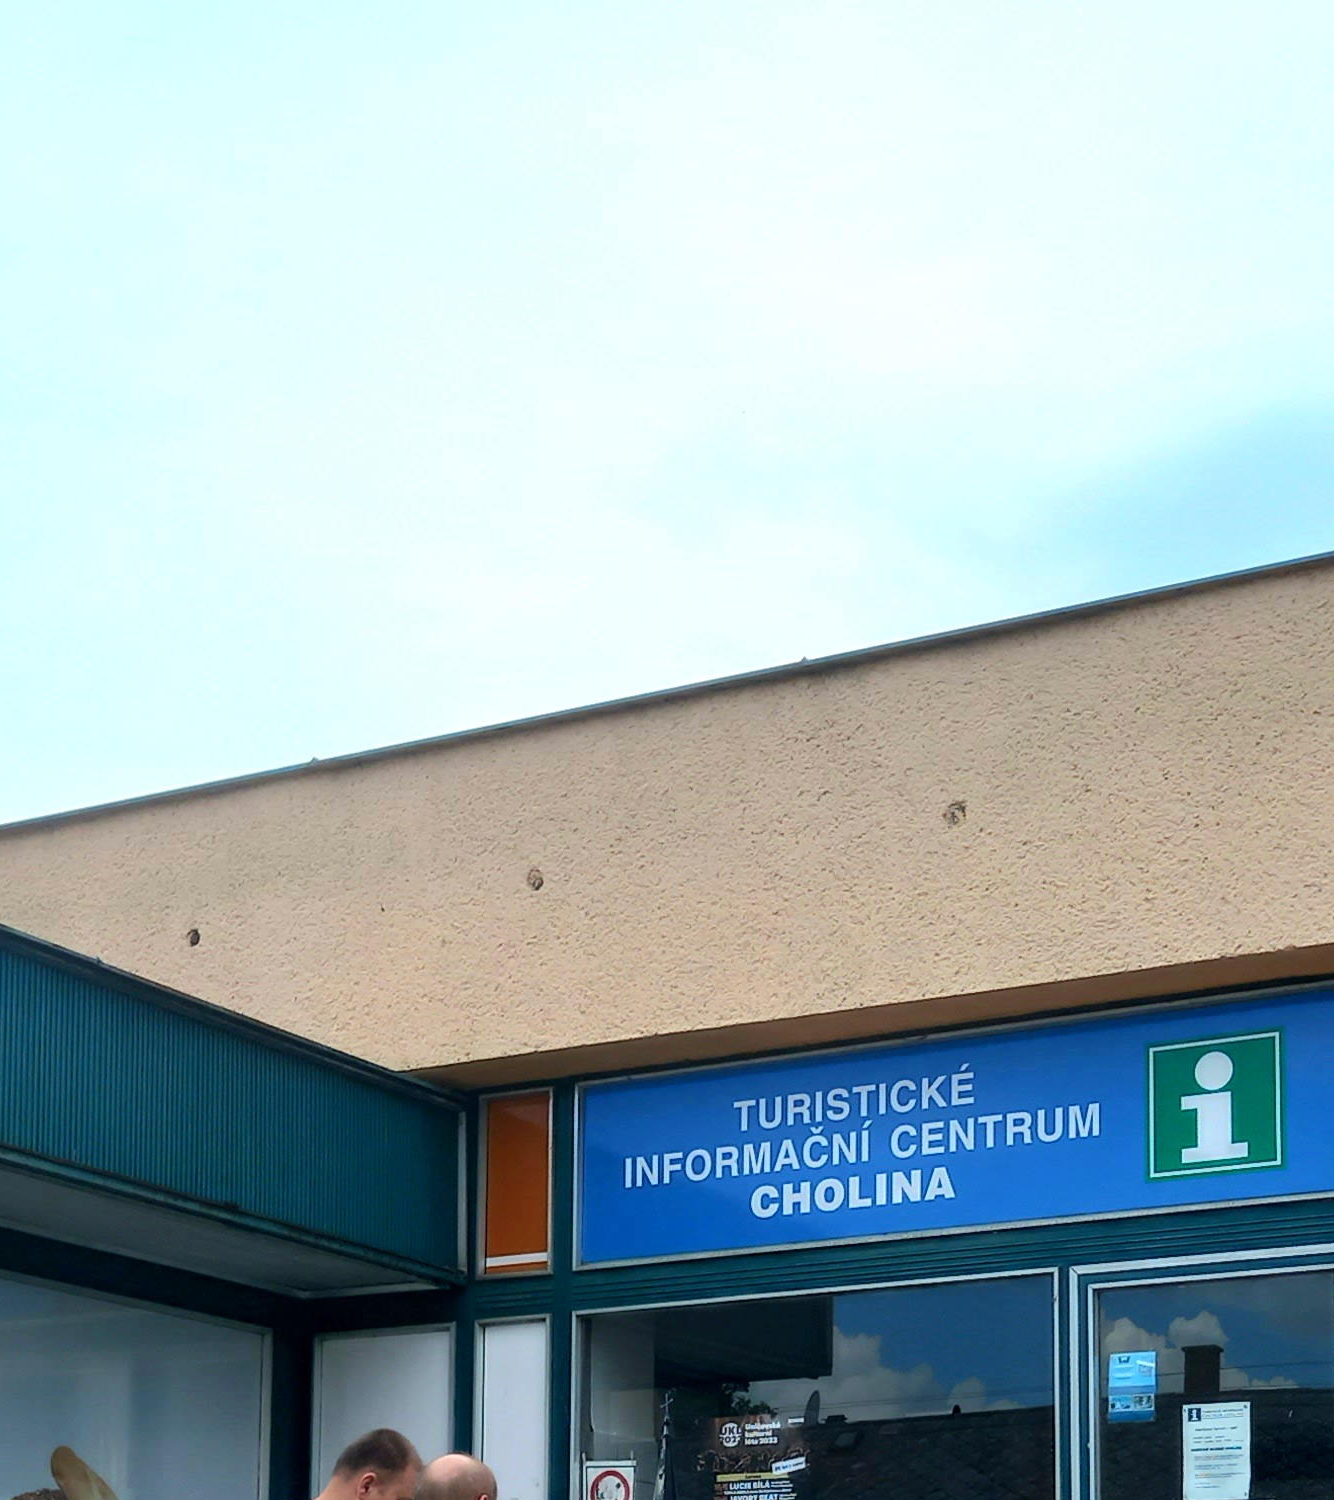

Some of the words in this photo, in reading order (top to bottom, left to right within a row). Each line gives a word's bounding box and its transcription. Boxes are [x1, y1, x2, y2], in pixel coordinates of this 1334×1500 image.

[733, 1063, 975, 1132] TURISTICKÉ
[624, 1120, 873, 1188] INFORMAČNÍ
[890, 1103, 1100, 1160] CENTRUM
[751, 1167, 956, 1219] CHOLINA
